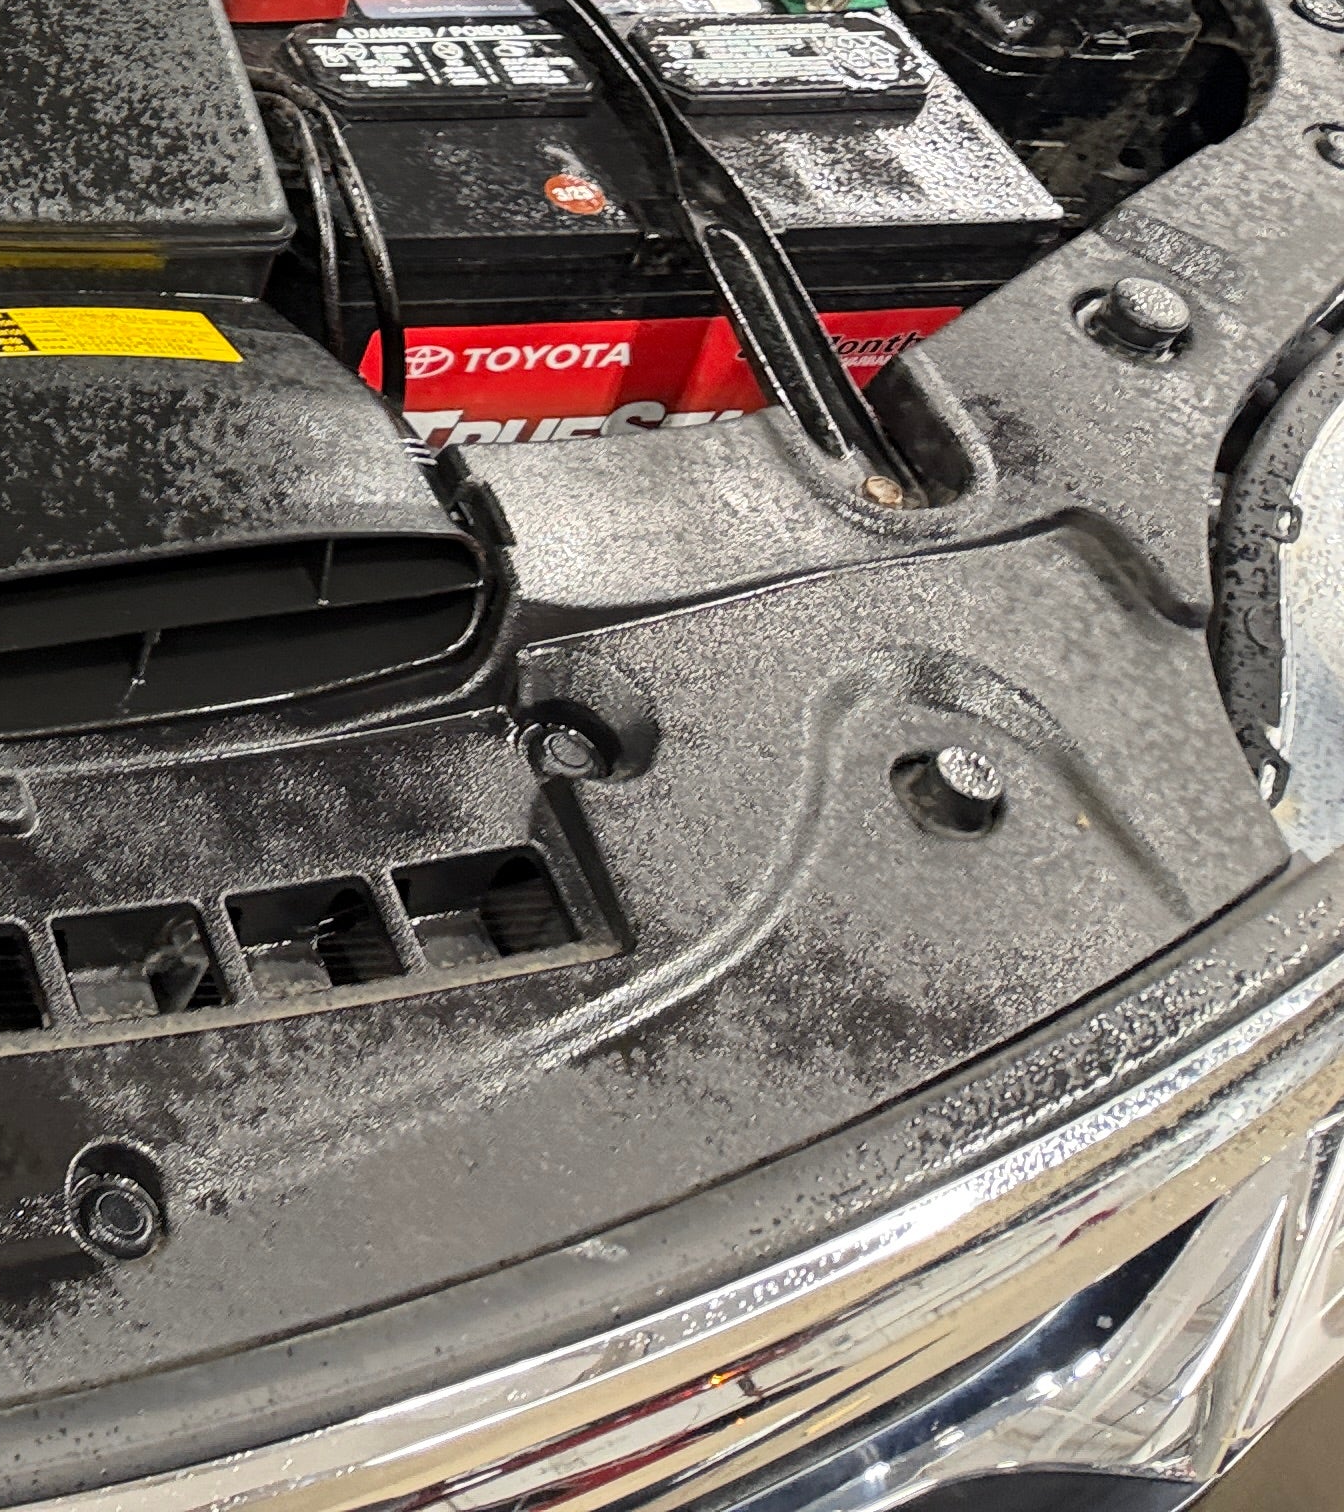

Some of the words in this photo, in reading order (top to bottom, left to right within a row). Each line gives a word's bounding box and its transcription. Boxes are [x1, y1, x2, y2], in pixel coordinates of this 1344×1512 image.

[353, 27, 434, 38] DANGER
[448, 25, 524, 37] POISON
[464, 342, 631, 373] TOYOTA
